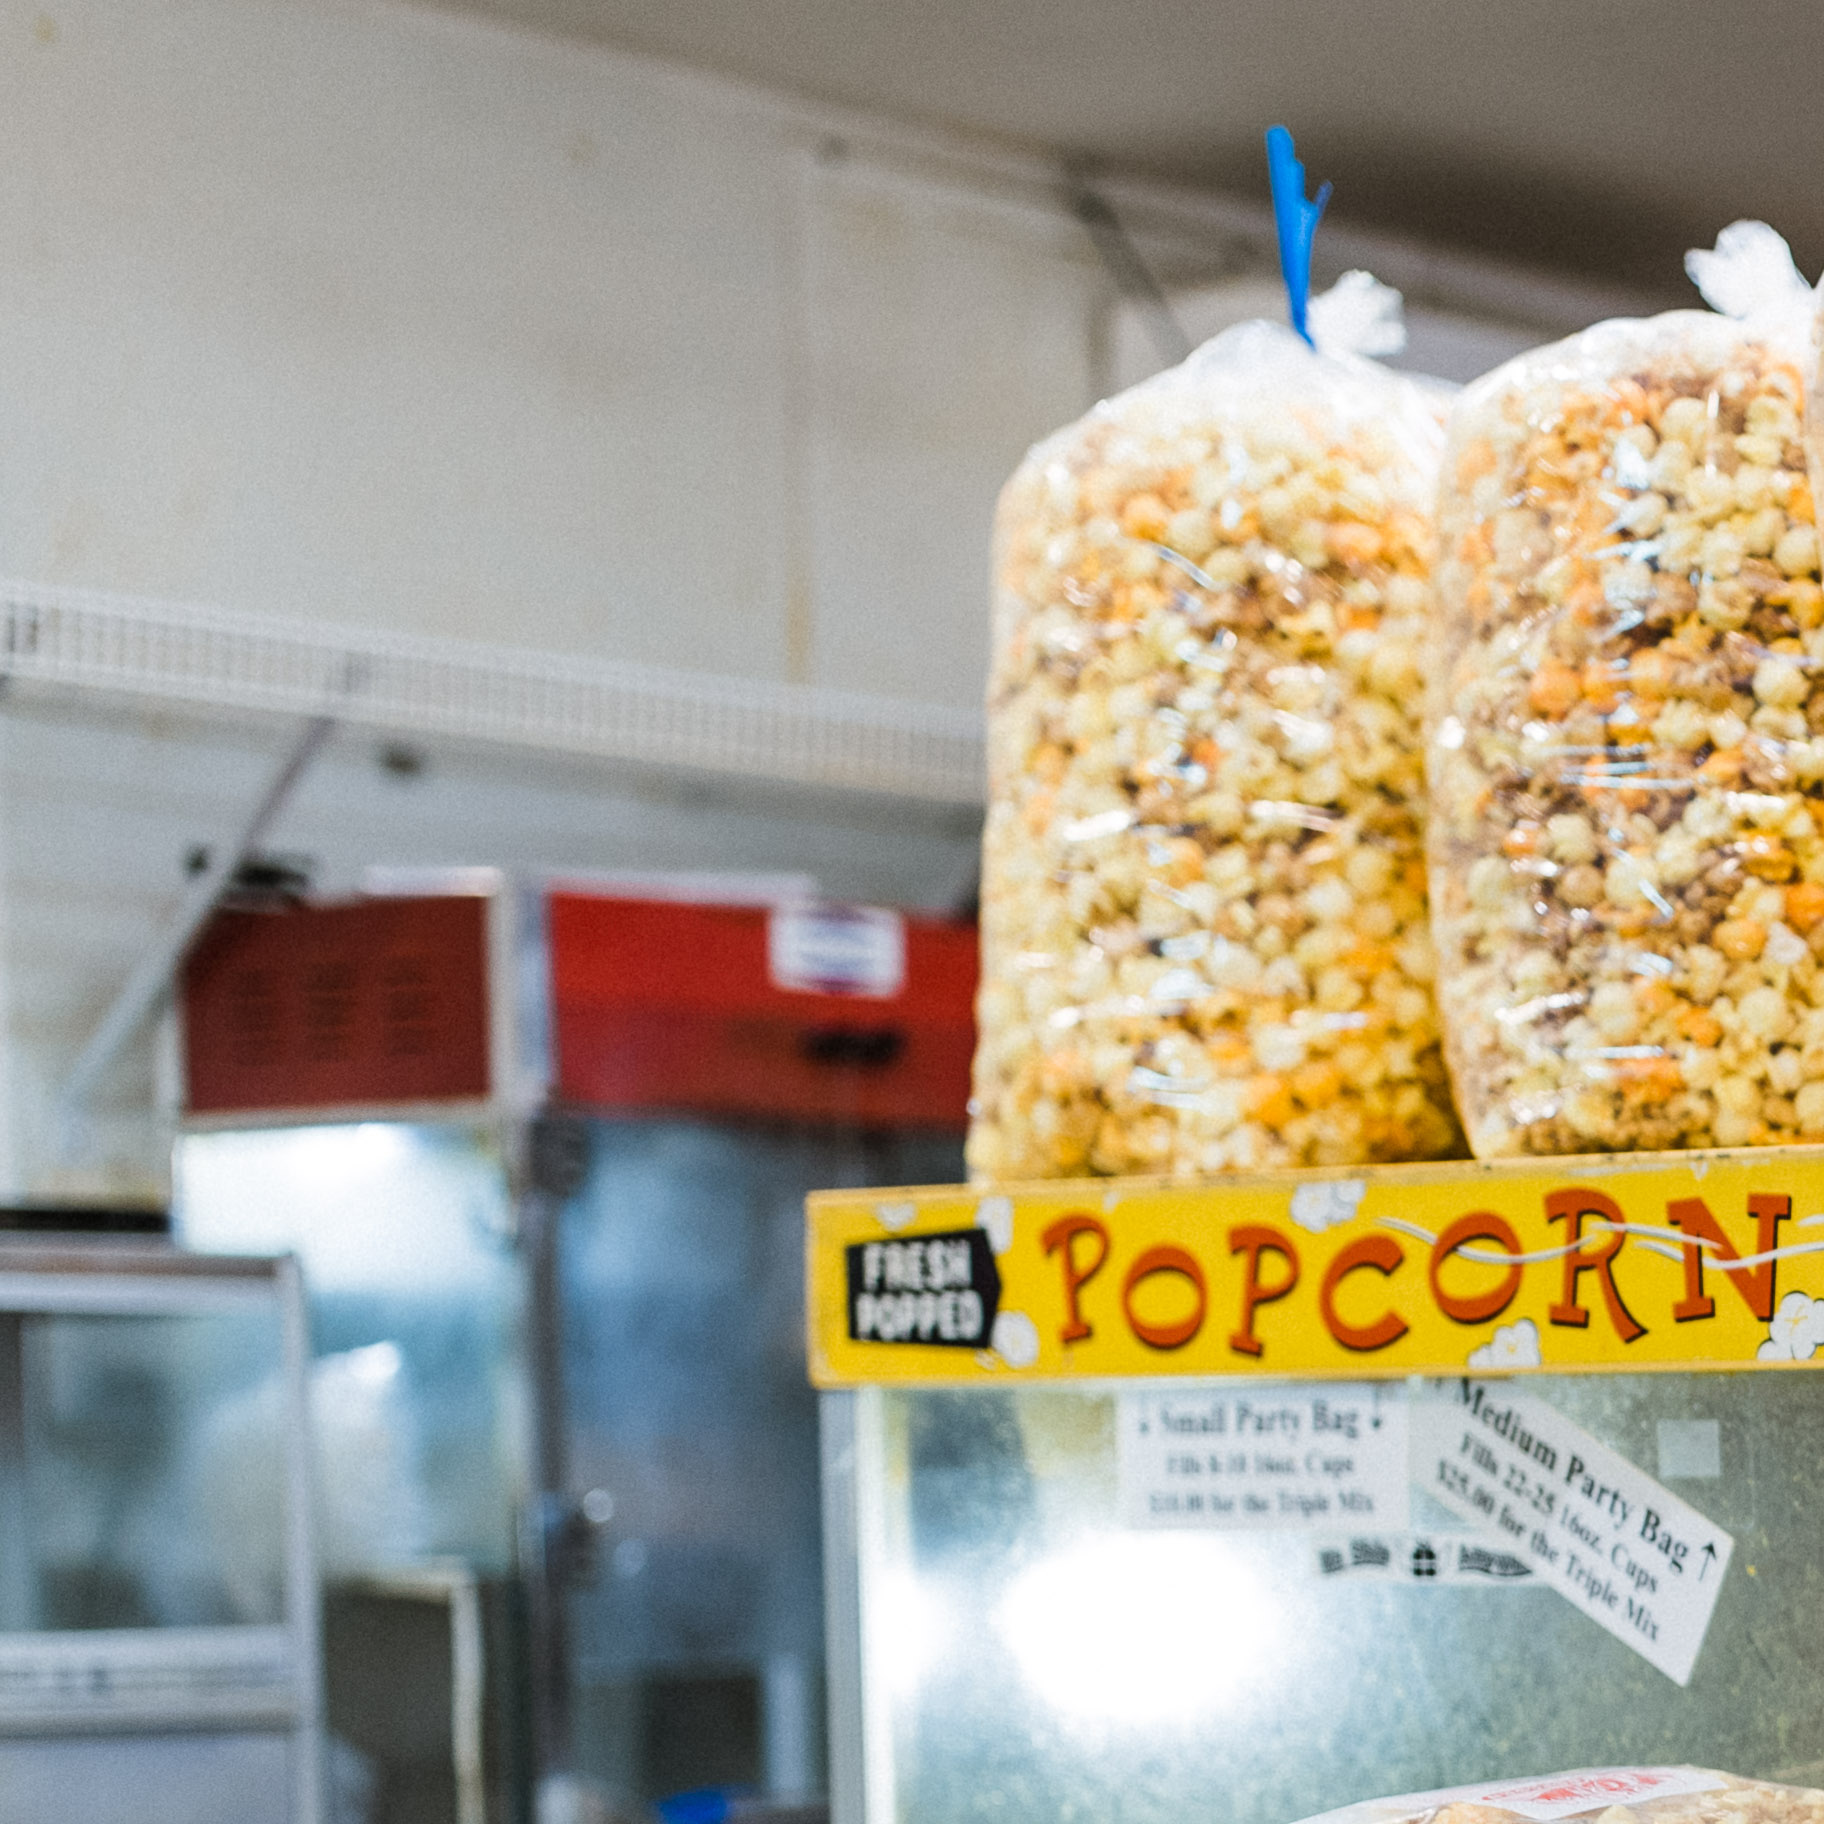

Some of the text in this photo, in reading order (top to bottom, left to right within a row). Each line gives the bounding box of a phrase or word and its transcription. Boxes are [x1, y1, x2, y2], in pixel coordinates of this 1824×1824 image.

[855, 1287, 985, 1341] POPPED
[862, 1240, 972, 1290] FRESH
[1039, 1188, 1793, 1356] POPCORN
[1235, 1400, 1300, 1442] Party
[1313, 1399, 1359, 1440] Bag
[1455, 1377, 1690, 1574] Medium Party Bag
[1460, 1432, 1499, 1477] Fills
[1503, 1463, 1556, 1514] 22-25
[1610, 1541, 1659, 1594] Cups
[1499, 1508, 1527, 1538] for
[1530, 1531, 1561, 1564] the
[1565, 1552, 1620, 1609] Triple
[1626, 1597, 1660, 1642] Mix
